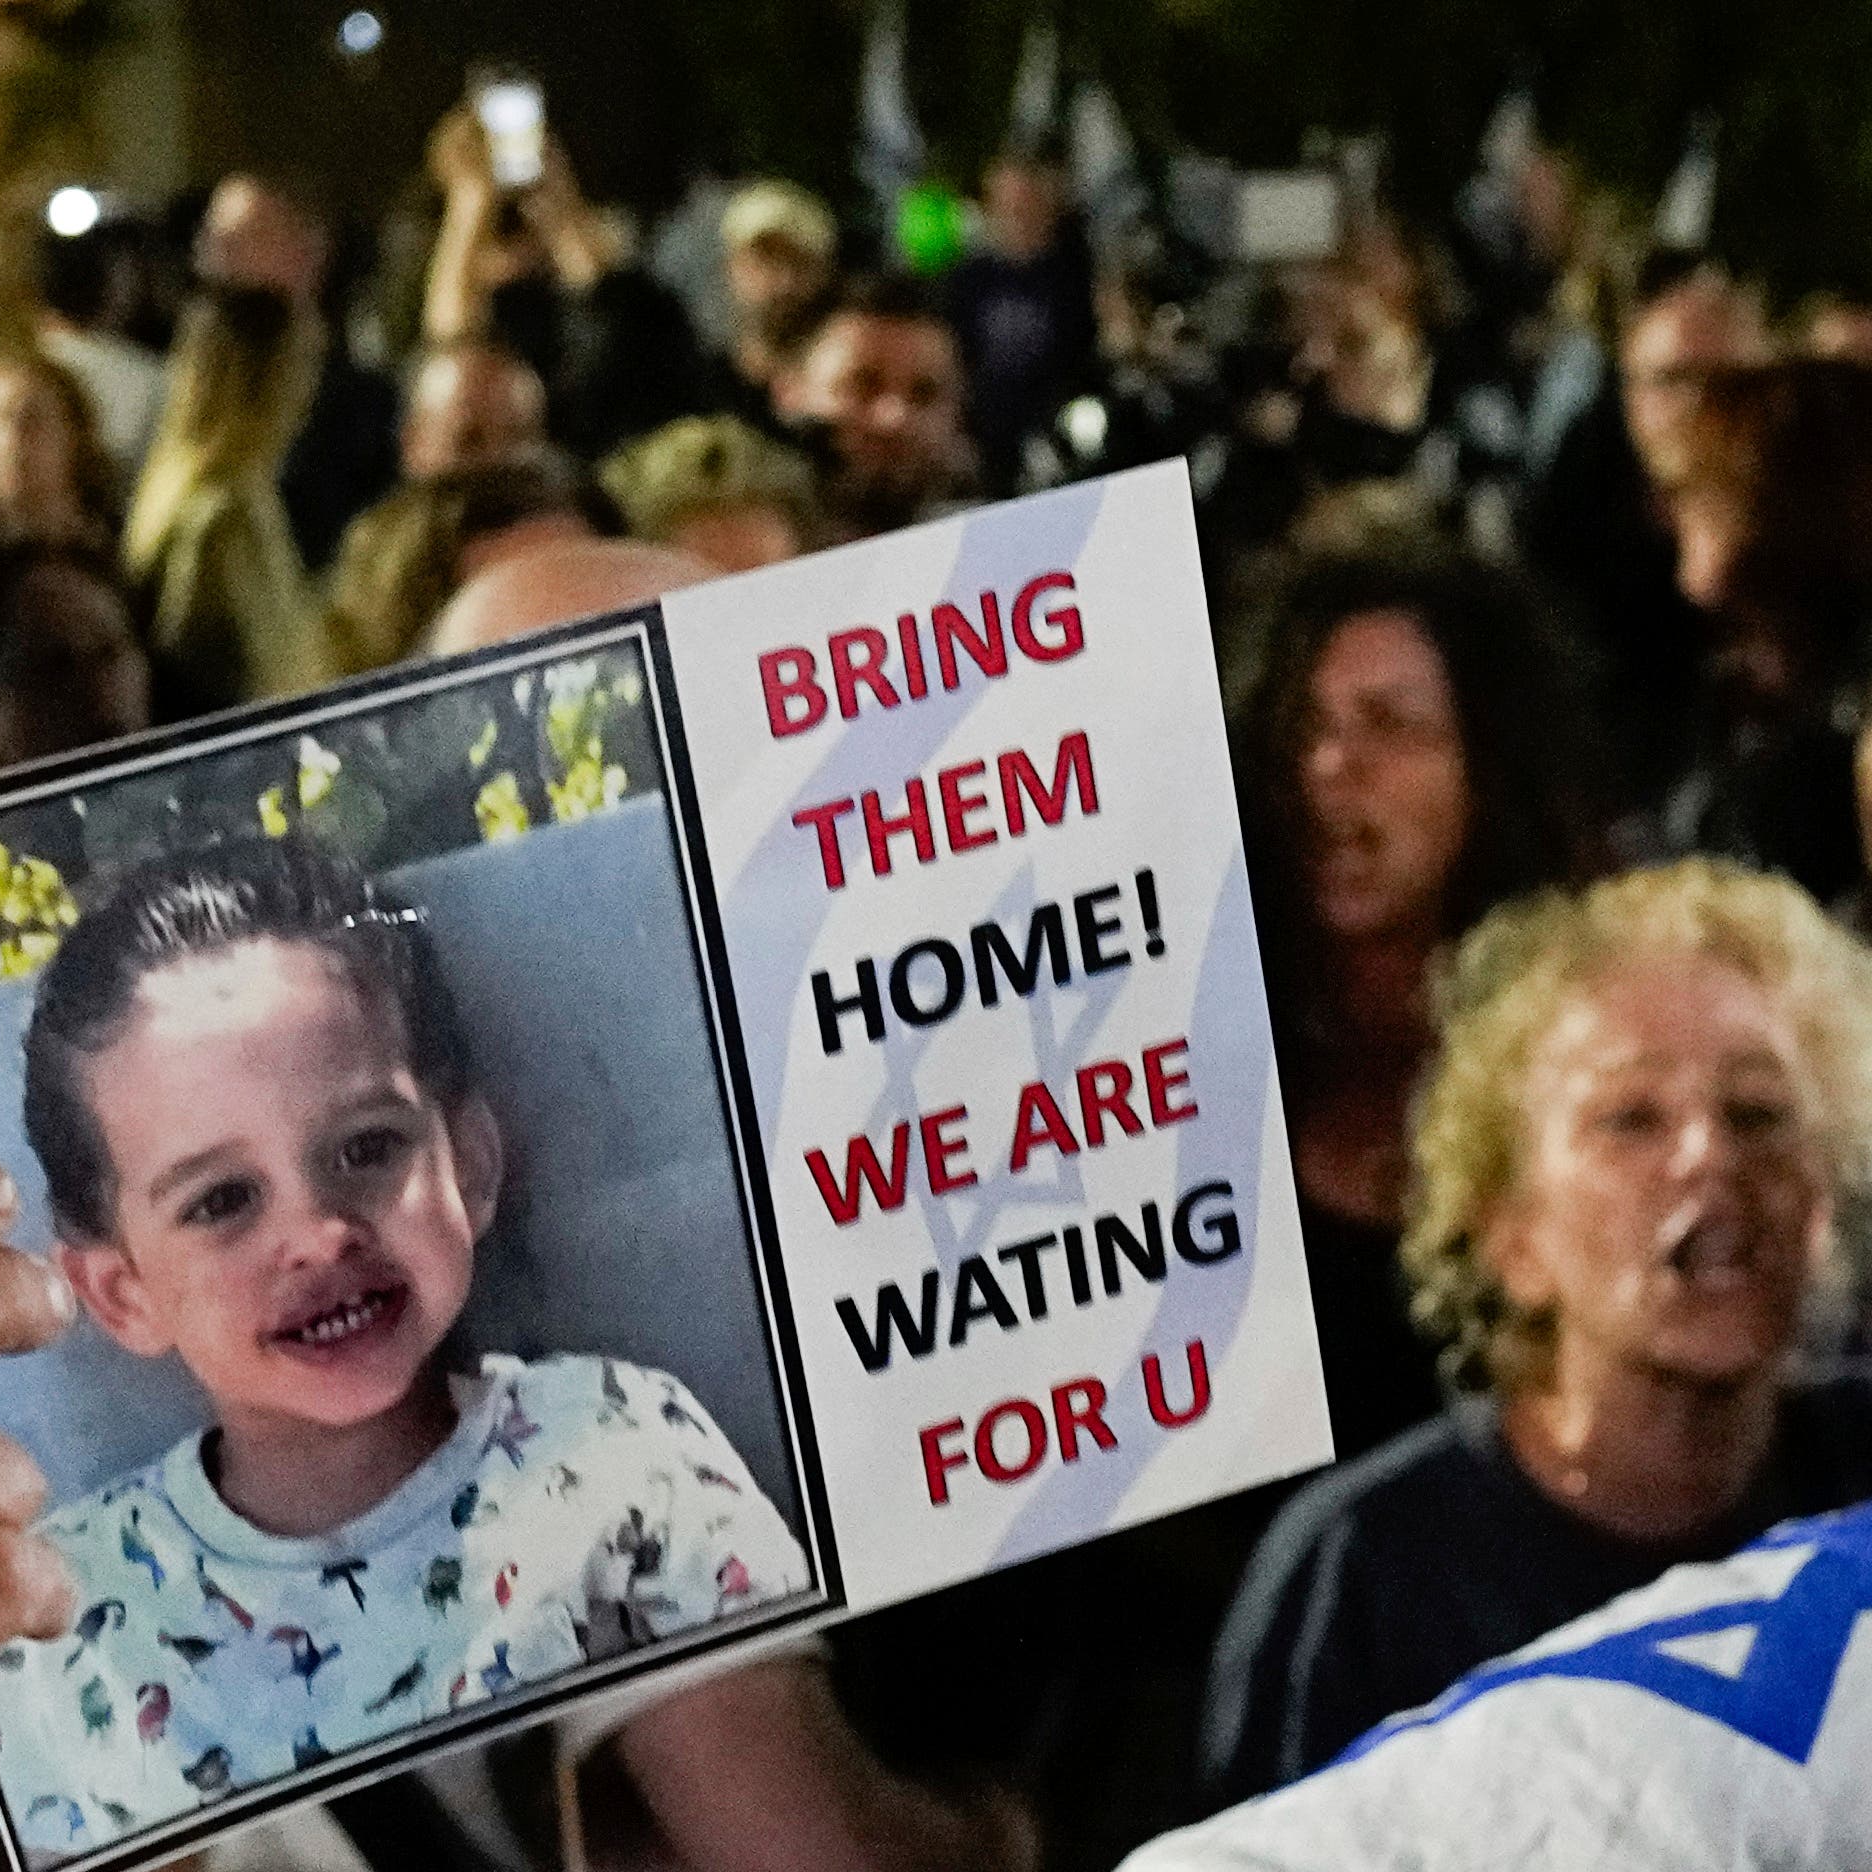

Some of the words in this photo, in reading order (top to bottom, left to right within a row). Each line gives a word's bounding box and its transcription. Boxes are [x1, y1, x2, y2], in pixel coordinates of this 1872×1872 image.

[756, 569, 1087, 741] BRING
[789, 728, 1102, 893] THEM
[808, 866, 1169, 1059] HOME!
[801, 1101, 981, 1230] WE
[1006, 1034, 1202, 1177] ARE
[832, 1176, 1245, 1377] WATING
[916, 1374, 1121, 1509] FOR
[1138, 1334, 1214, 1432] U
